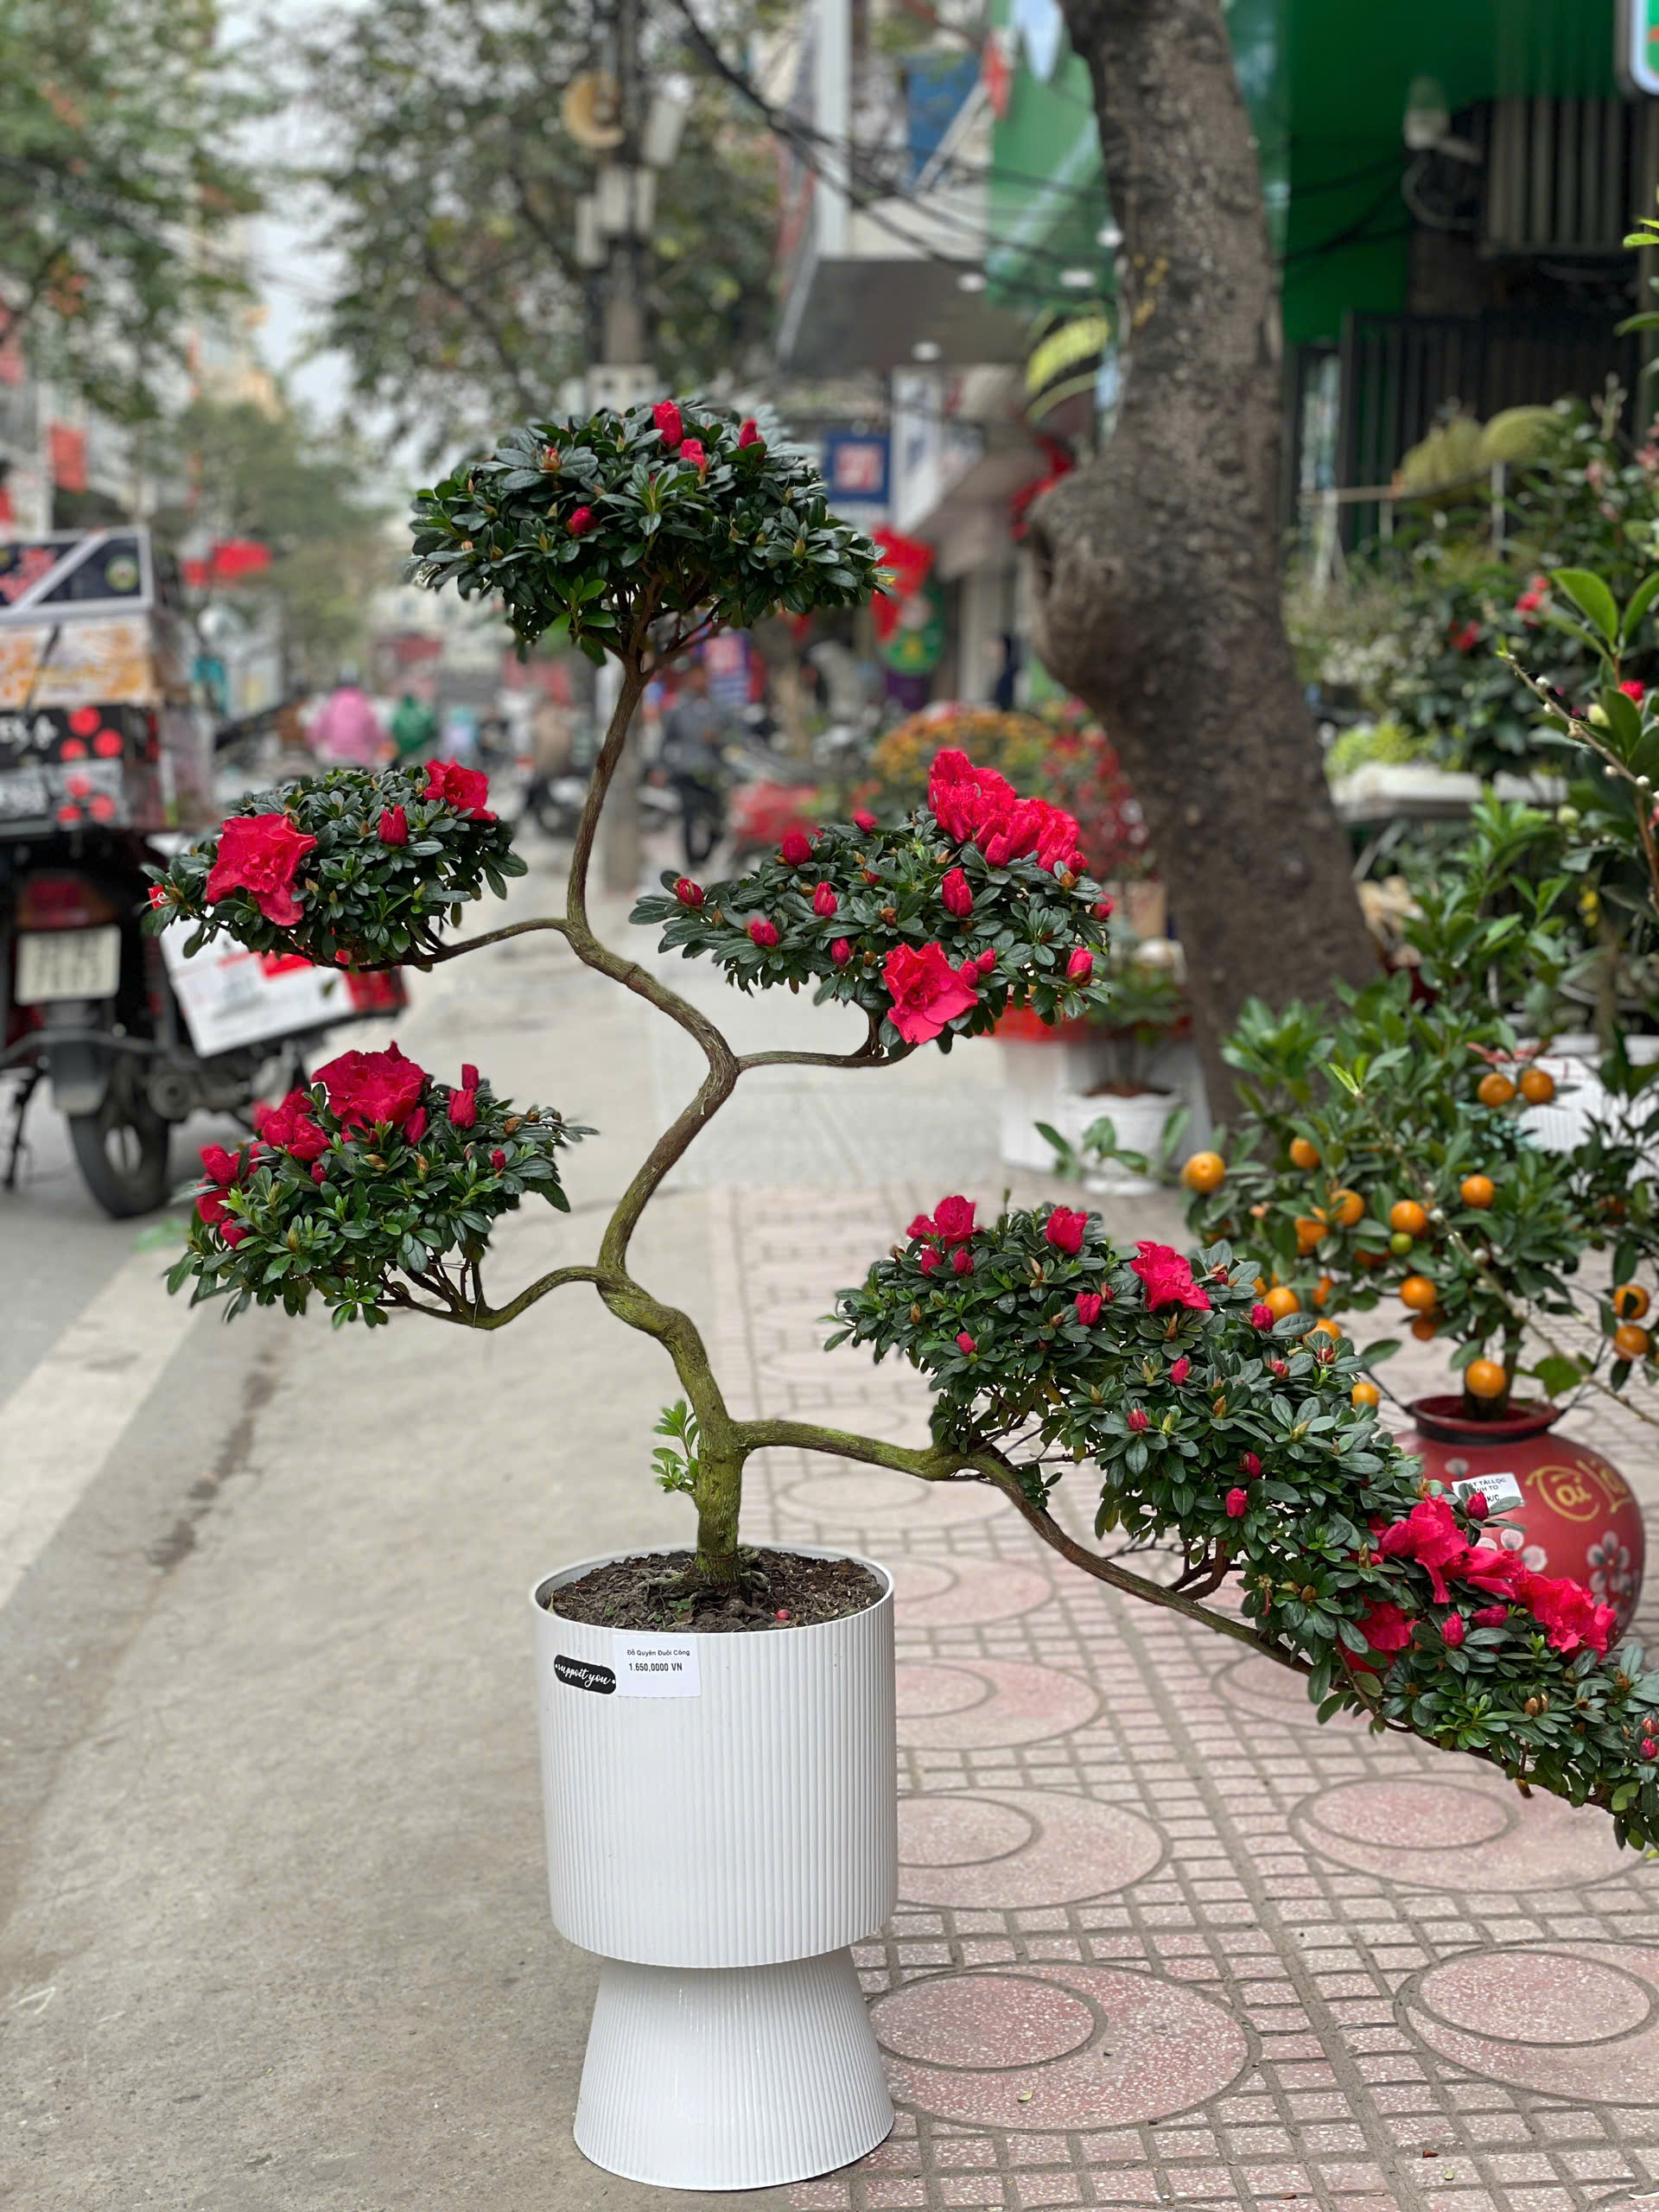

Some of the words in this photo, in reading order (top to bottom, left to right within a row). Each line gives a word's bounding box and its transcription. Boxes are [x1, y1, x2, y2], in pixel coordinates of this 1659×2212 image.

[628, 1662, 669, 1672] 1.650,0000
[671, 1662, 683, 1671] VN
[584, 1673, 612, 1688] you
